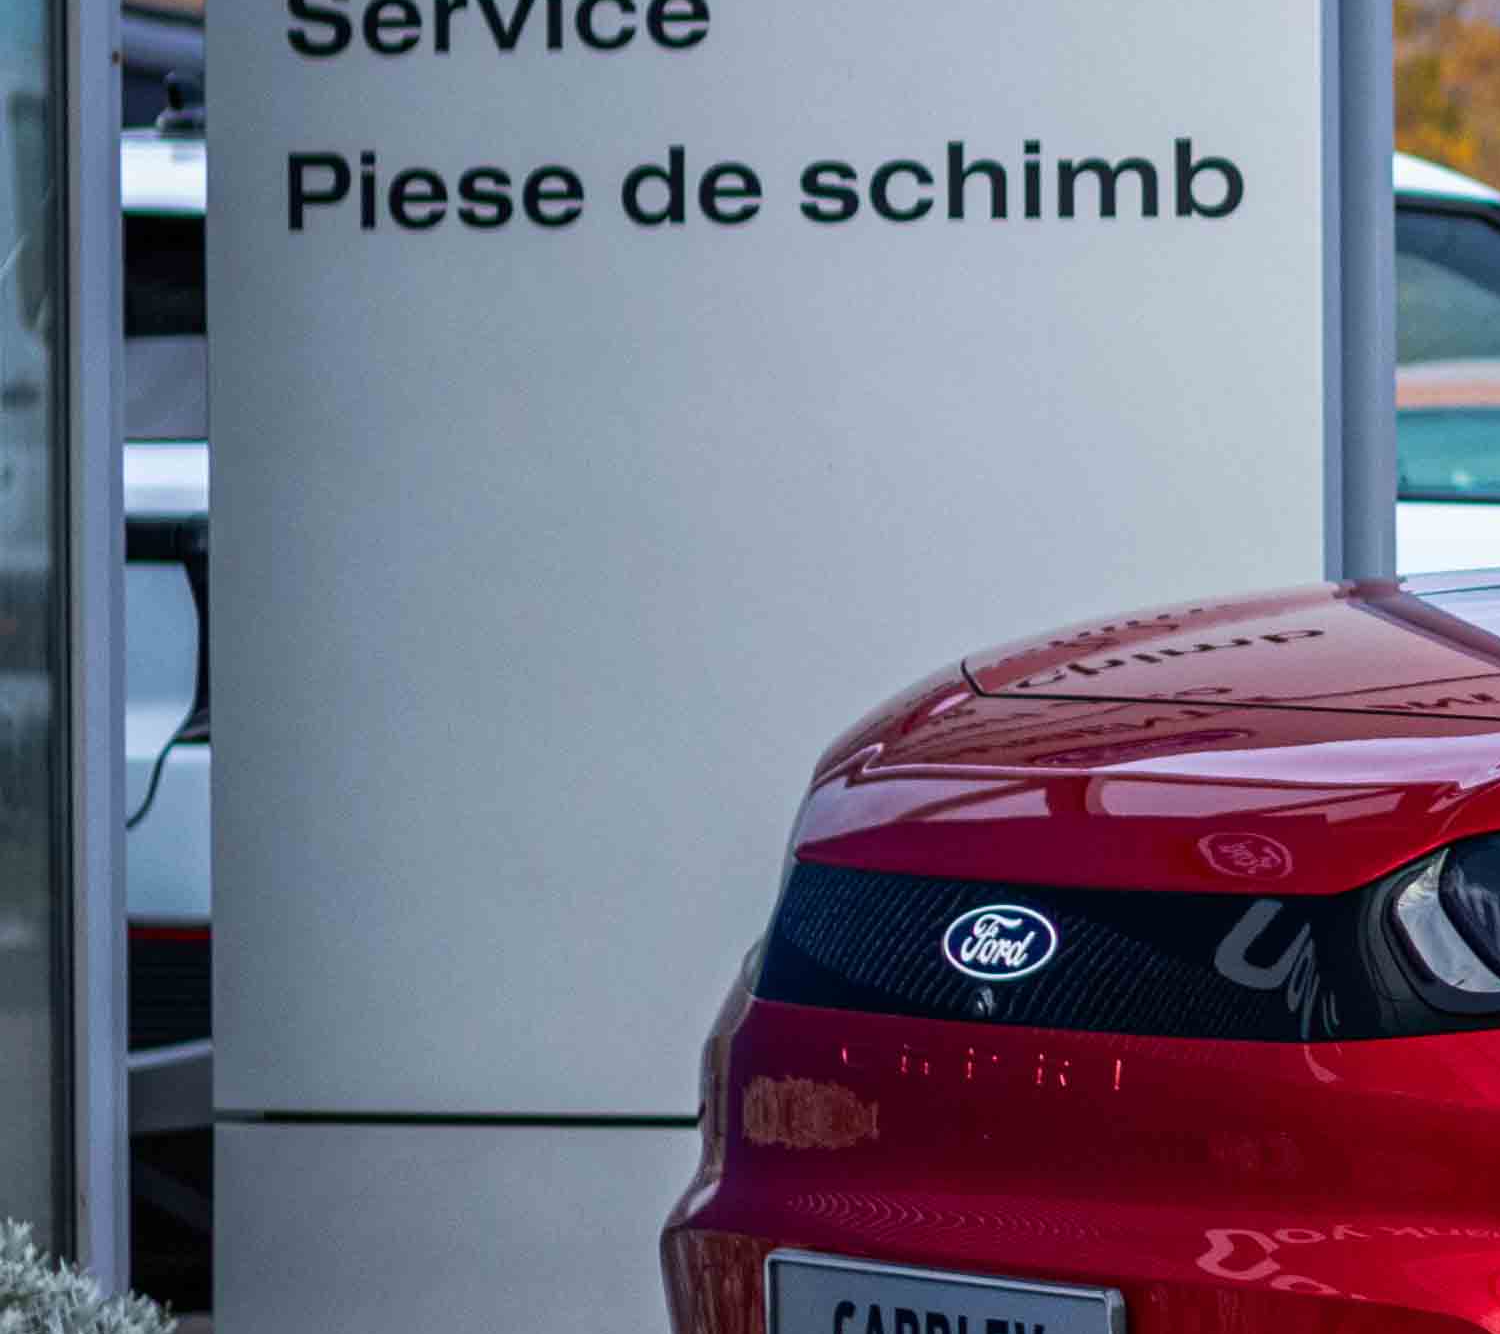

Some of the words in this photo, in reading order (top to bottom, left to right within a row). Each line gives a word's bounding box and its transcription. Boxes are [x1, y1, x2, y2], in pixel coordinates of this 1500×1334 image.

[286, 149, 586, 234] Piese
[620, 144, 763, 228] de
[799, 138, 1244, 224] schimb
[961, 914, 1037, 968] Ford
